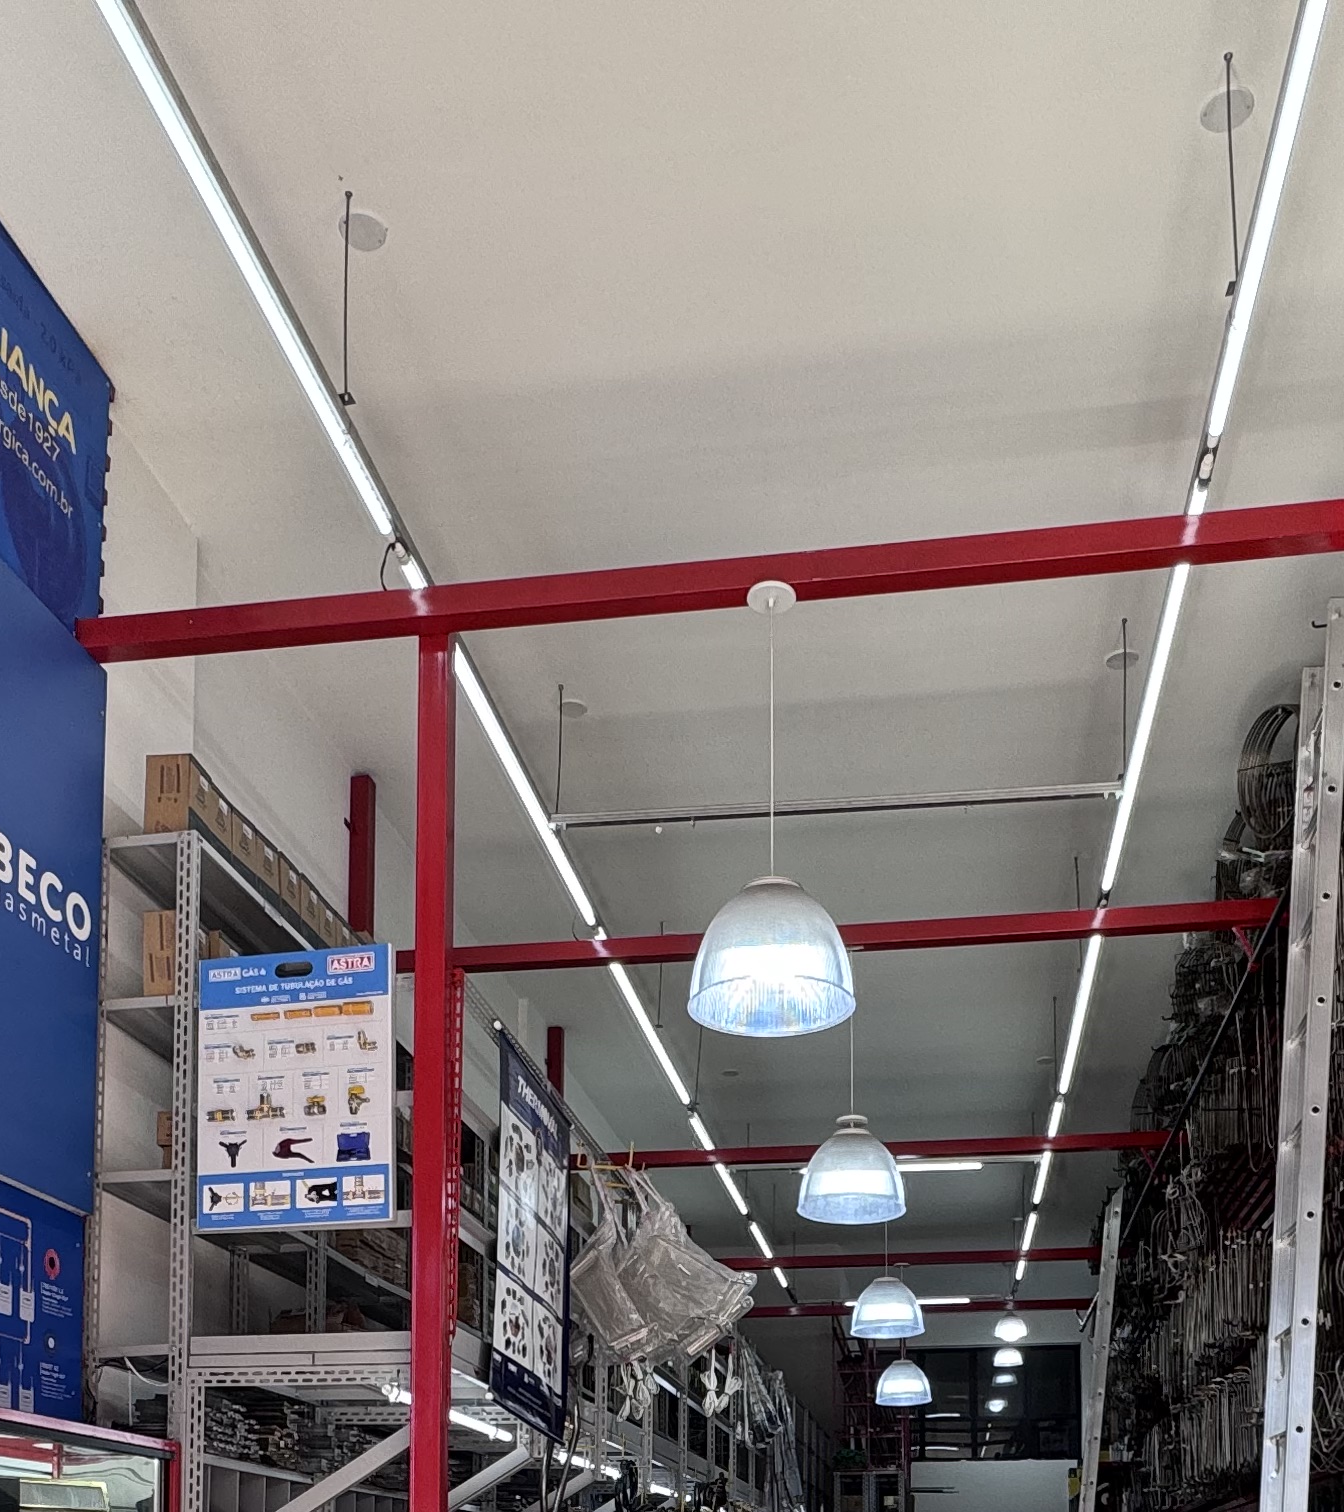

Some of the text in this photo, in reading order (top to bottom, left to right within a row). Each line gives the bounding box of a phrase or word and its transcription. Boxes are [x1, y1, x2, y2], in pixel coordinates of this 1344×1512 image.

[331, 955, 372, 971] ASTRA
[211, 969, 239, 980] ASTRA
[235, 976, 353, 995] SISTEMA DE TUBULAÇÃO DE GÁS
